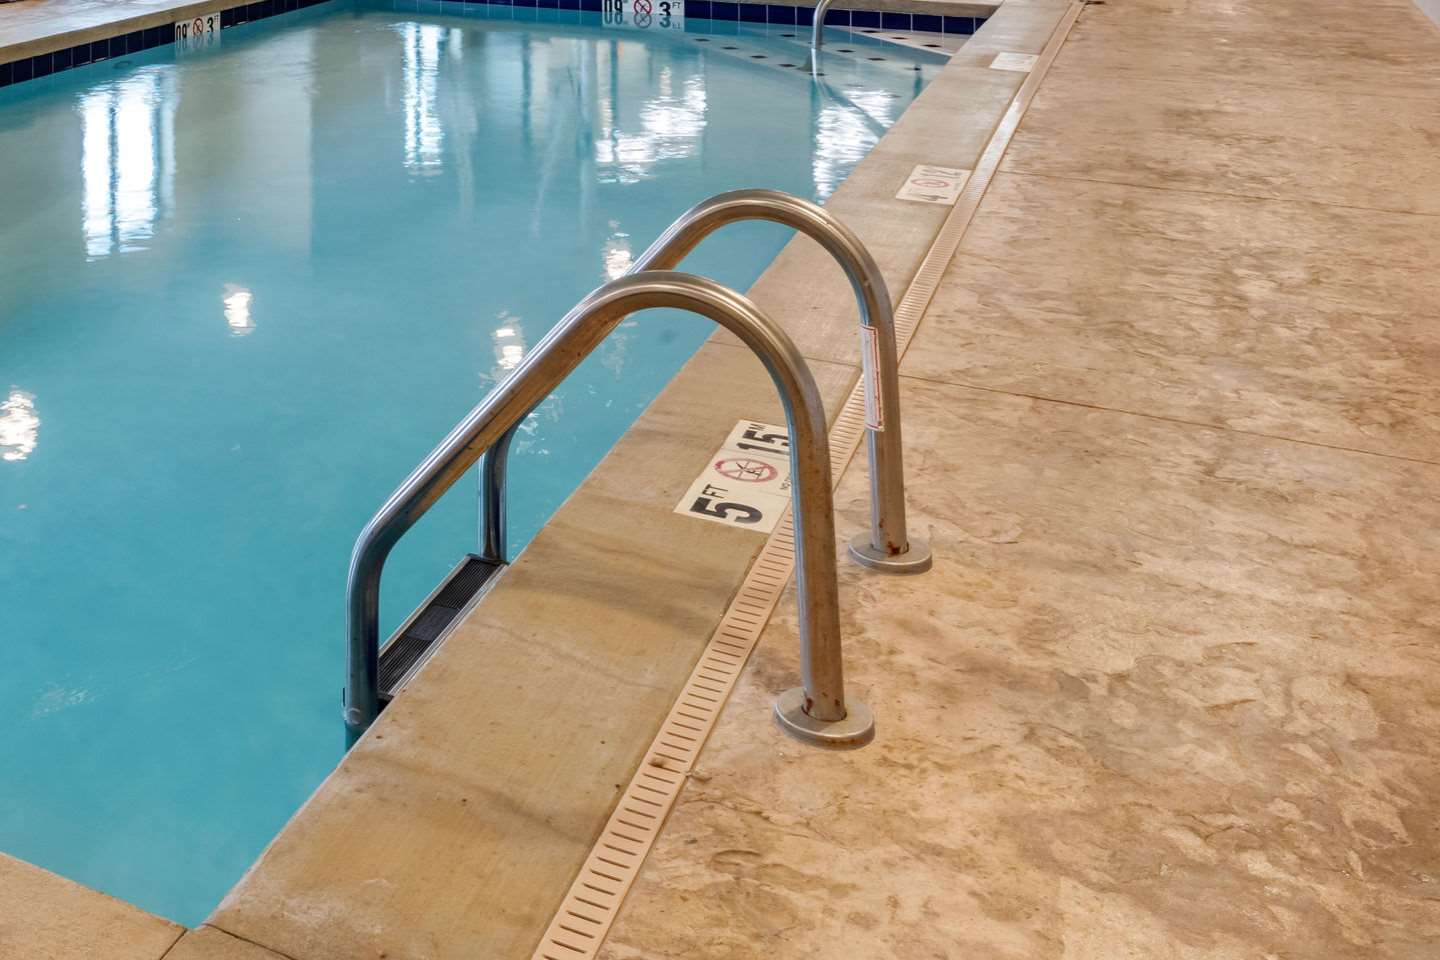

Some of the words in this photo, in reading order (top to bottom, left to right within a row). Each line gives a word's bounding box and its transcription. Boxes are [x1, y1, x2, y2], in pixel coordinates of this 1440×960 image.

[659, 1, 671, 17] 3
[207, 16, 214, 32] 3
[736, 429, 791, 456] 15
[702, 483, 729, 499] FT
[689, 496, 763, 525] 5
